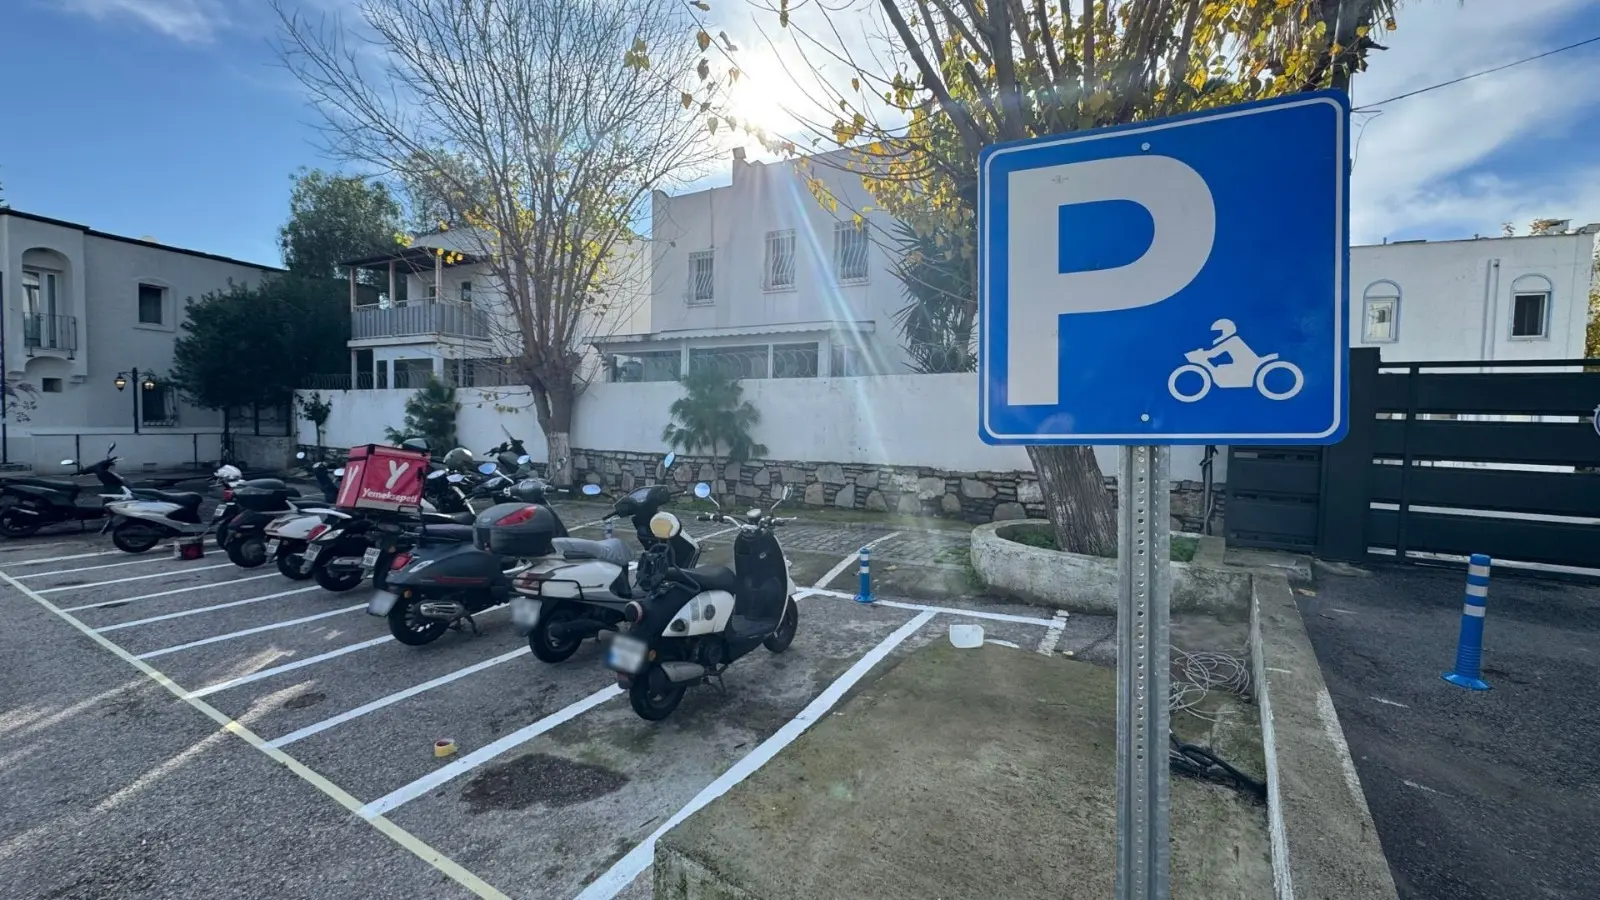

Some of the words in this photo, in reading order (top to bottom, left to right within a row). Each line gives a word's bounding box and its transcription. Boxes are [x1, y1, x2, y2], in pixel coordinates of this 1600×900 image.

[1007, 154, 1216, 406] P
[385, 460, 409, 489] Y
[362, 488, 418, 502] Yemeksepeti
